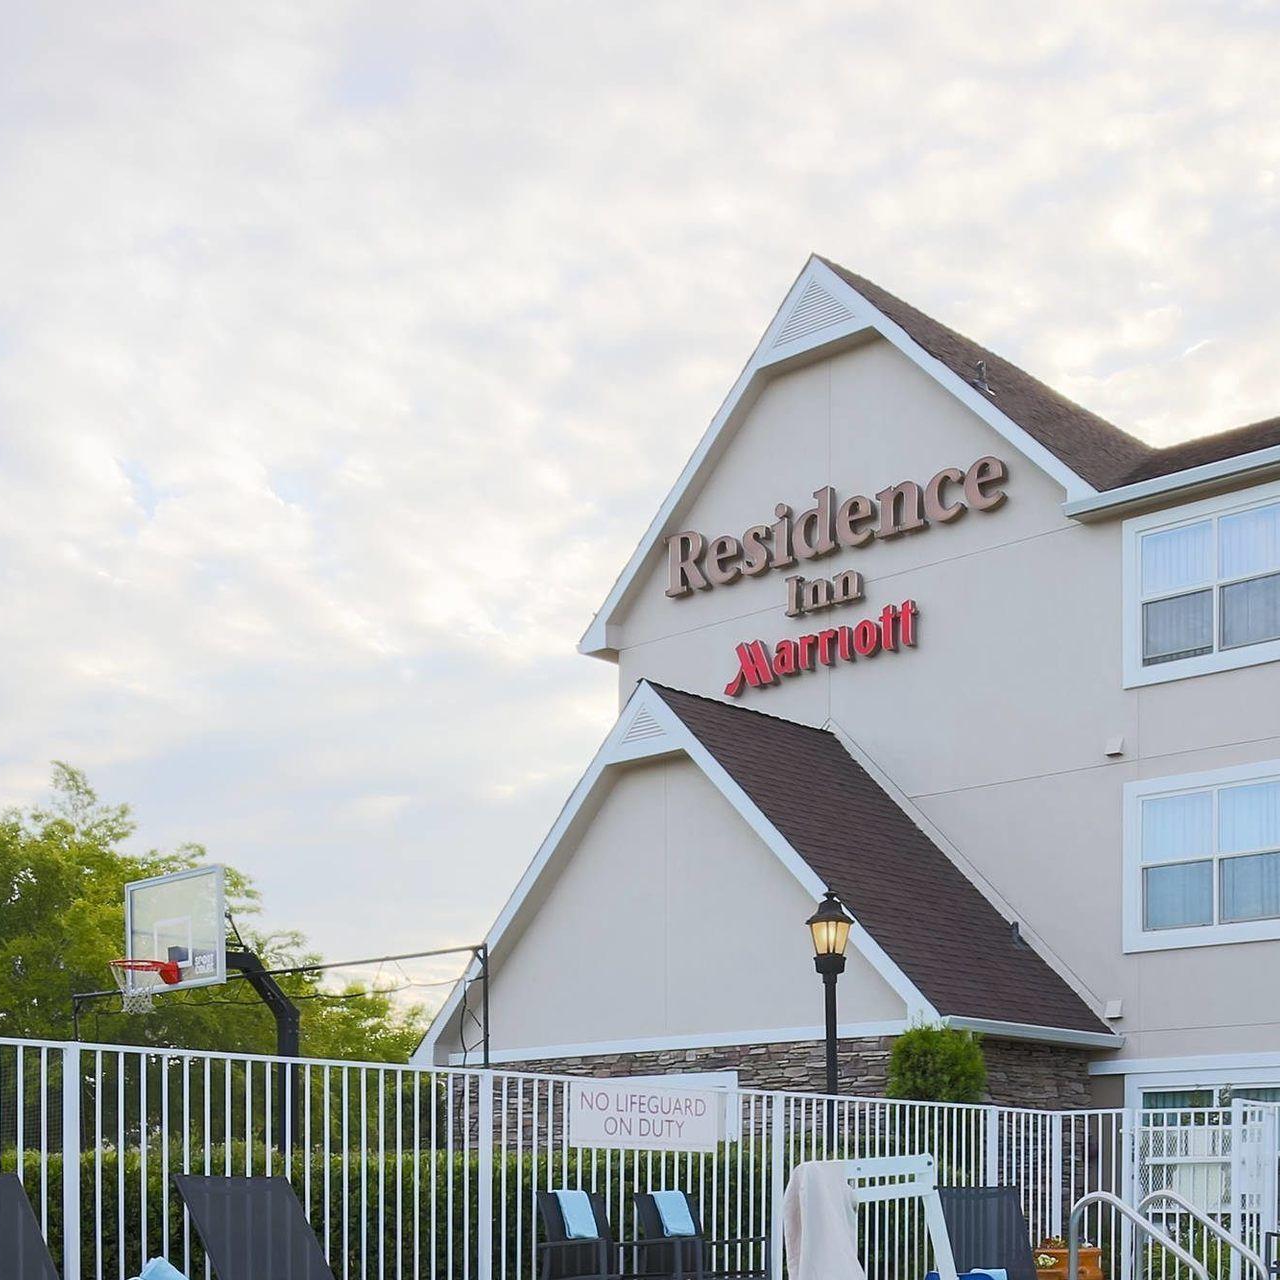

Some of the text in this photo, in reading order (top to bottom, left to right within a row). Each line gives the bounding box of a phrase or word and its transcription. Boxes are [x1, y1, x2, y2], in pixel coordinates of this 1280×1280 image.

[663, 455, 1009, 599] Residence
[785, 567, 867, 617] Inn
[724, 599, 919, 697] Marriott
[580, 1091, 706, 1117] NO LIFEGUARD
[604, 1116, 685, 1138] ON DUTY
